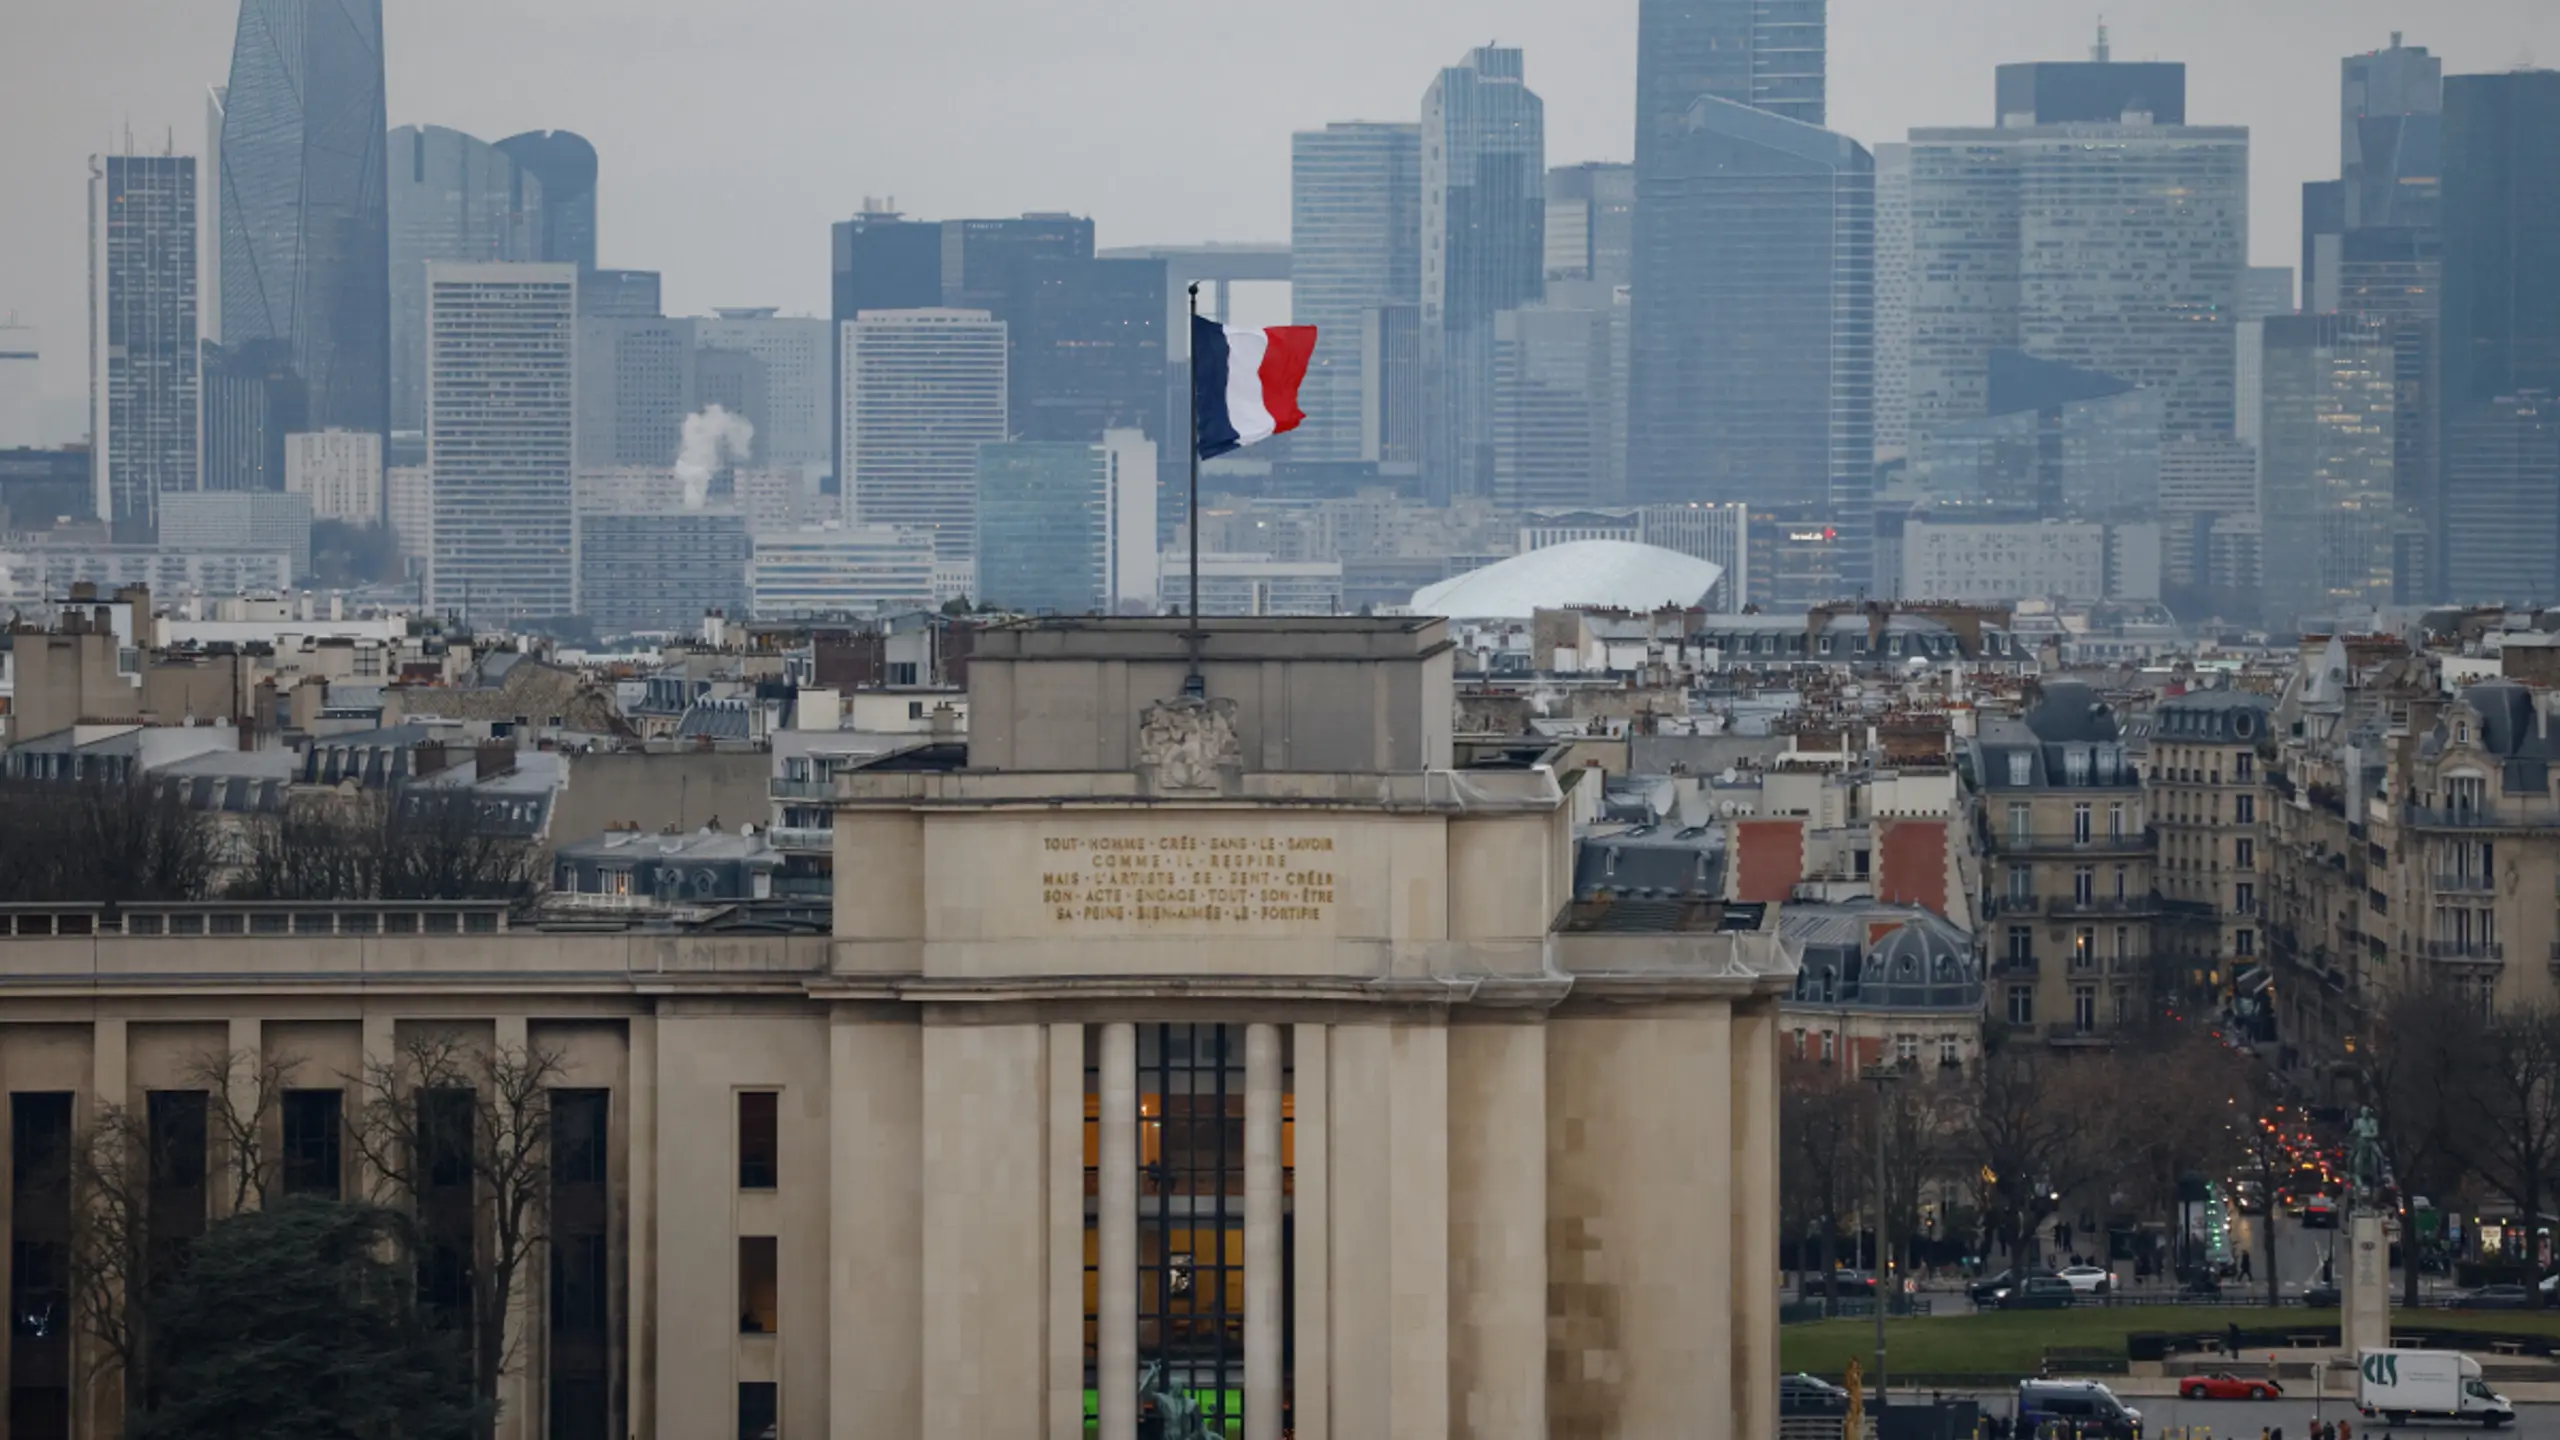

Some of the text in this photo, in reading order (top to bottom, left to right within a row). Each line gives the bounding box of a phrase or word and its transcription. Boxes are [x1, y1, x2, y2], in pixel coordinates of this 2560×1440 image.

[1043, 835, 1333, 850] TOUT HOMME CRÉE SANS LE SAVOIR
[1091, 854, 1286, 868] COMME IL RESPIRE
[1043, 872, 1079, 885] MAIS
[1192, 871, 1213, 885] SE
[1229, 871, 1269, 885] SENT
[1086, 888, 1122, 901] ACTE
[1136, 888, 1196, 902] ENGAGE
[1208, 888, 1247, 902] TOUT
[1260, 888, 1290, 902] SON
[1056, 906, 1073, 920] SA
[1234, 906, 1249, 920] LE
[1260, 906, 1320, 920] FORTIFIE
[2363, 1353, 2398, 1388] CLS
